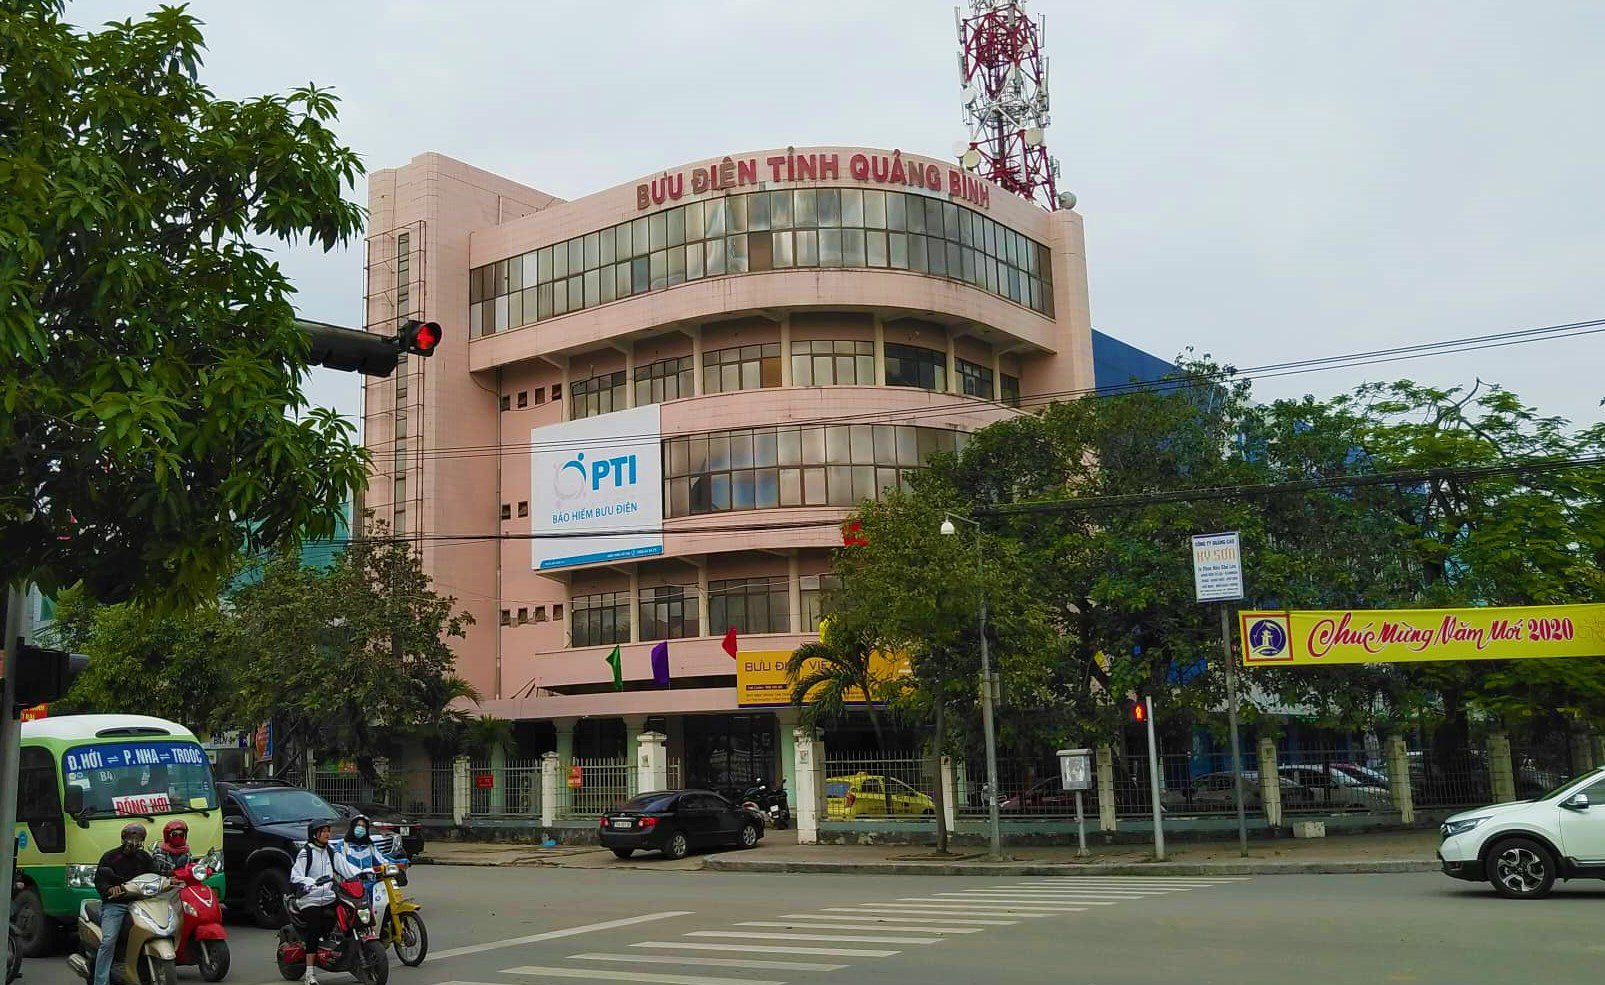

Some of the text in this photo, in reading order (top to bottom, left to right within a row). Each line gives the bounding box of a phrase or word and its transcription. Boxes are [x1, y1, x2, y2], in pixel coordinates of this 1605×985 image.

[636, 171, 683, 210] BƯU
[767, 146, 839, 182] TỈNH
[850, 149, 941, 192] QUẢNG
[592, 454, 636, 491] PTI
[552, 511, 570, 524] BẢO
[595, 504, 614, 517] BƯU
[1307, 612, 1574, 657] Chúc Mừng Năm Mới 2020
[745, 659, 771, 672] BƯU
